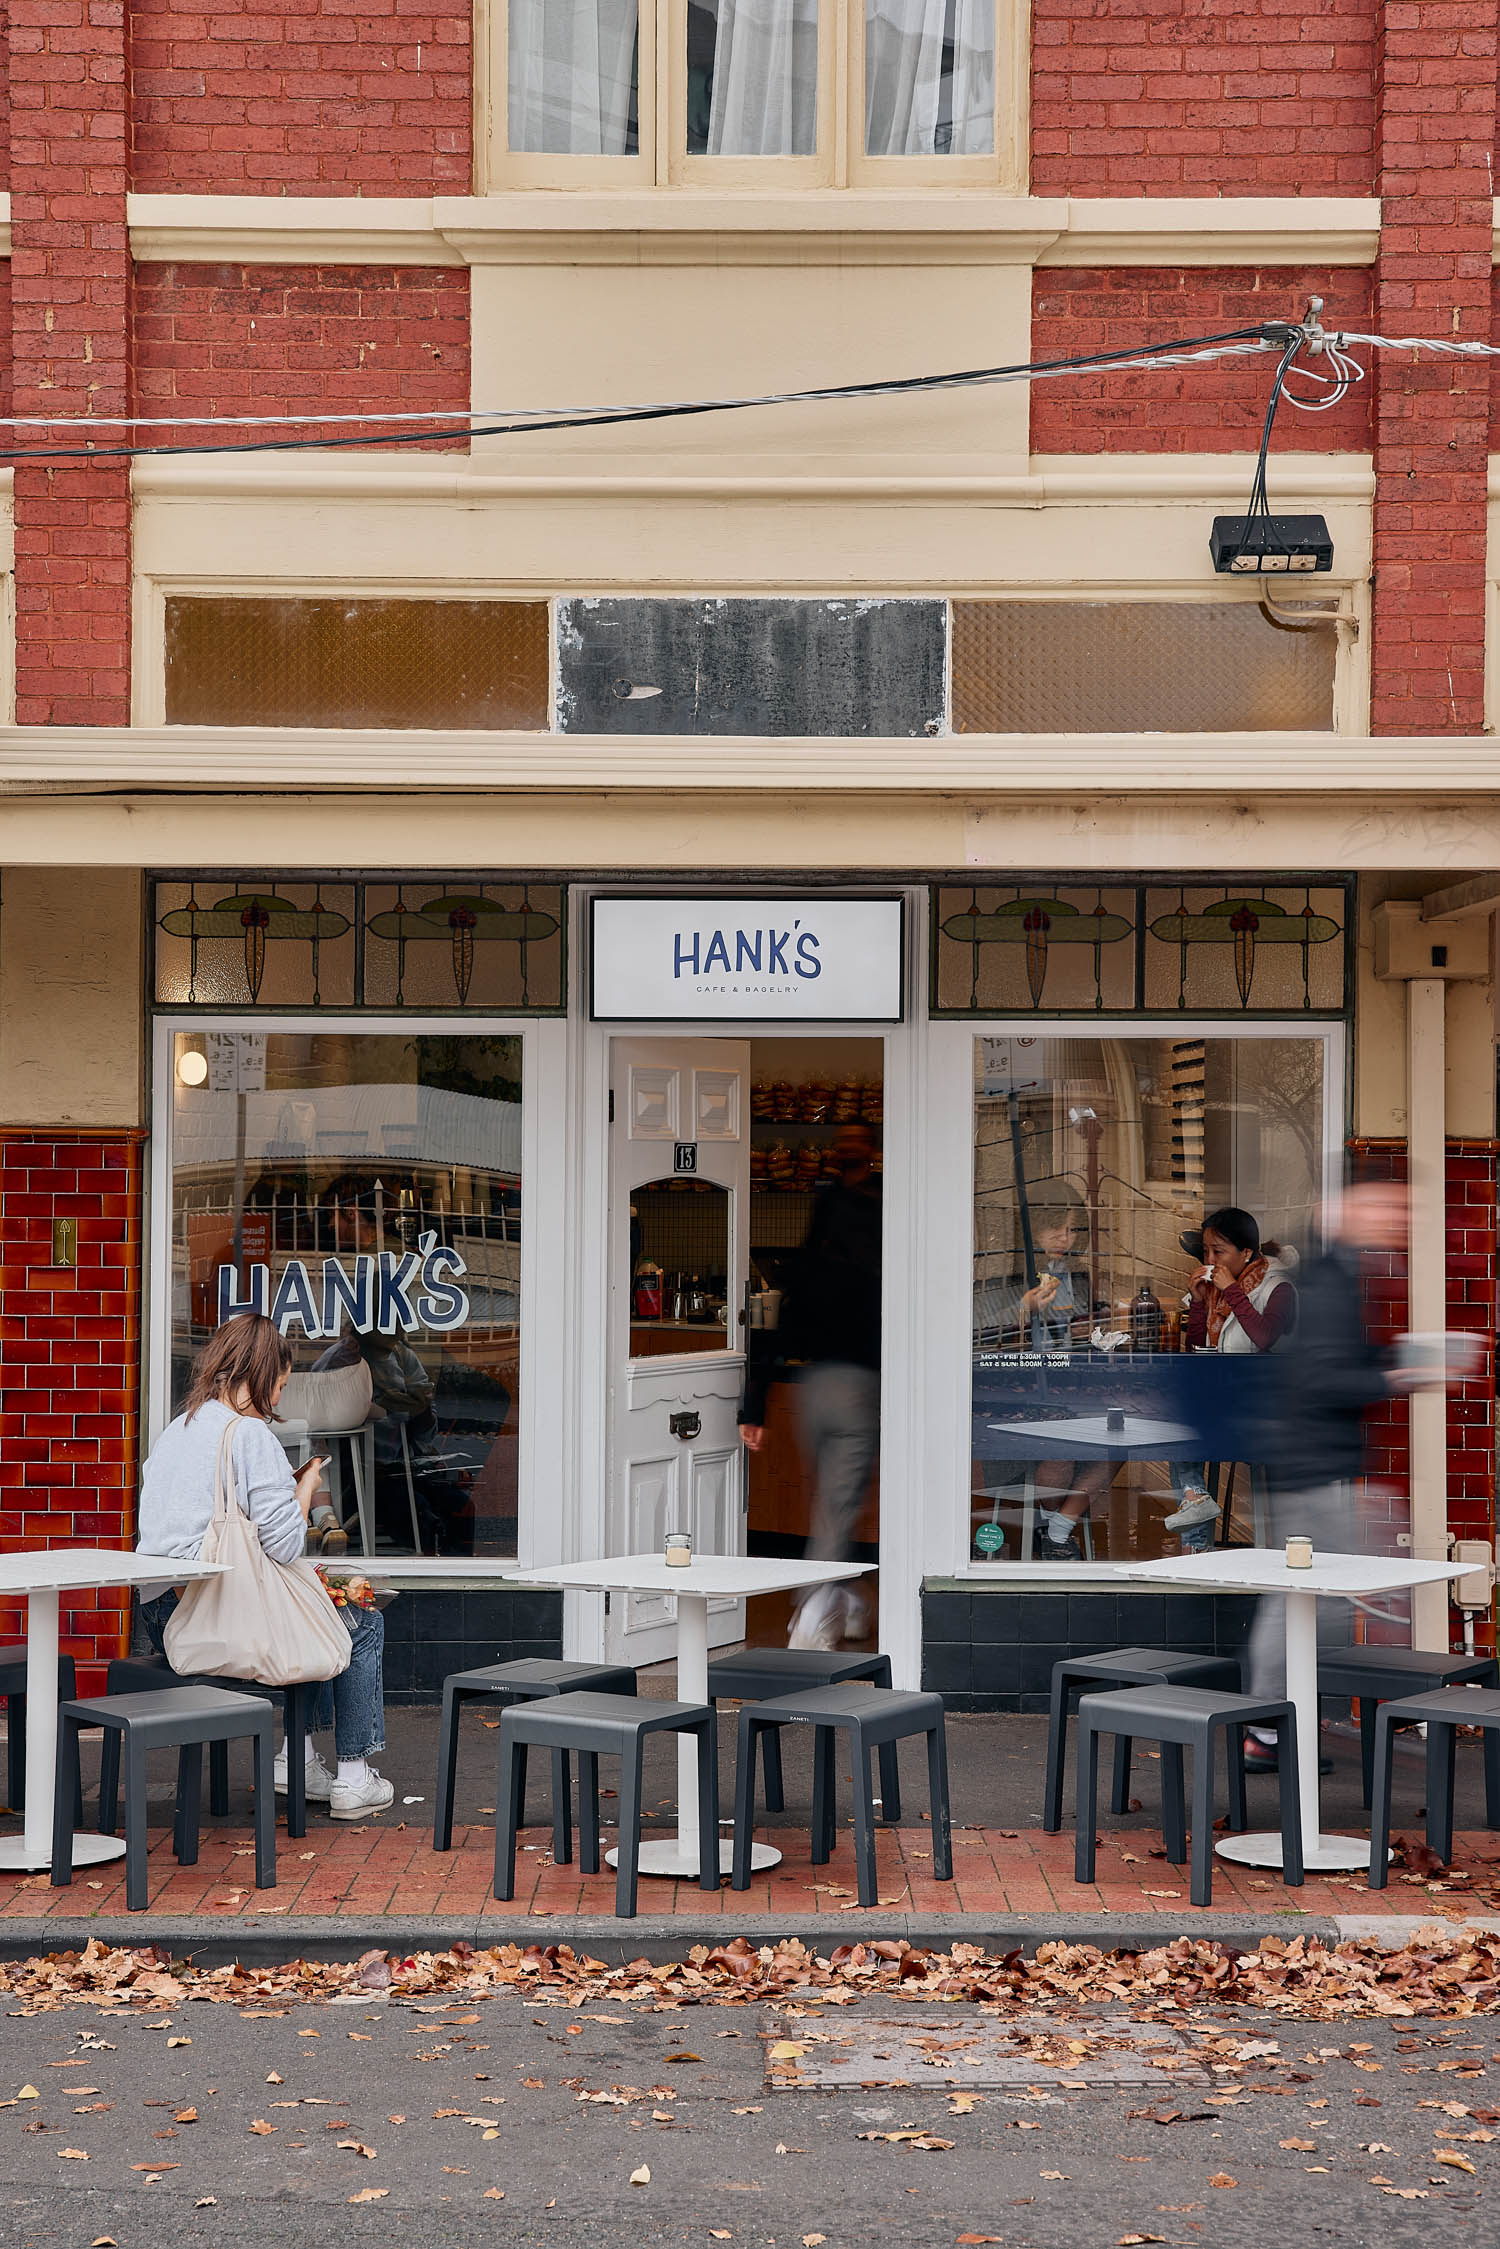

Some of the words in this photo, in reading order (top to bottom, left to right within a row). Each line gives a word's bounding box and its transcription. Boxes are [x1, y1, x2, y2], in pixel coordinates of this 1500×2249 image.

[674, 920, 821, 979] HANK'S
[680, 1147, 692, 1168] 13
[217, 1229, 470, 1340] HANK'S
